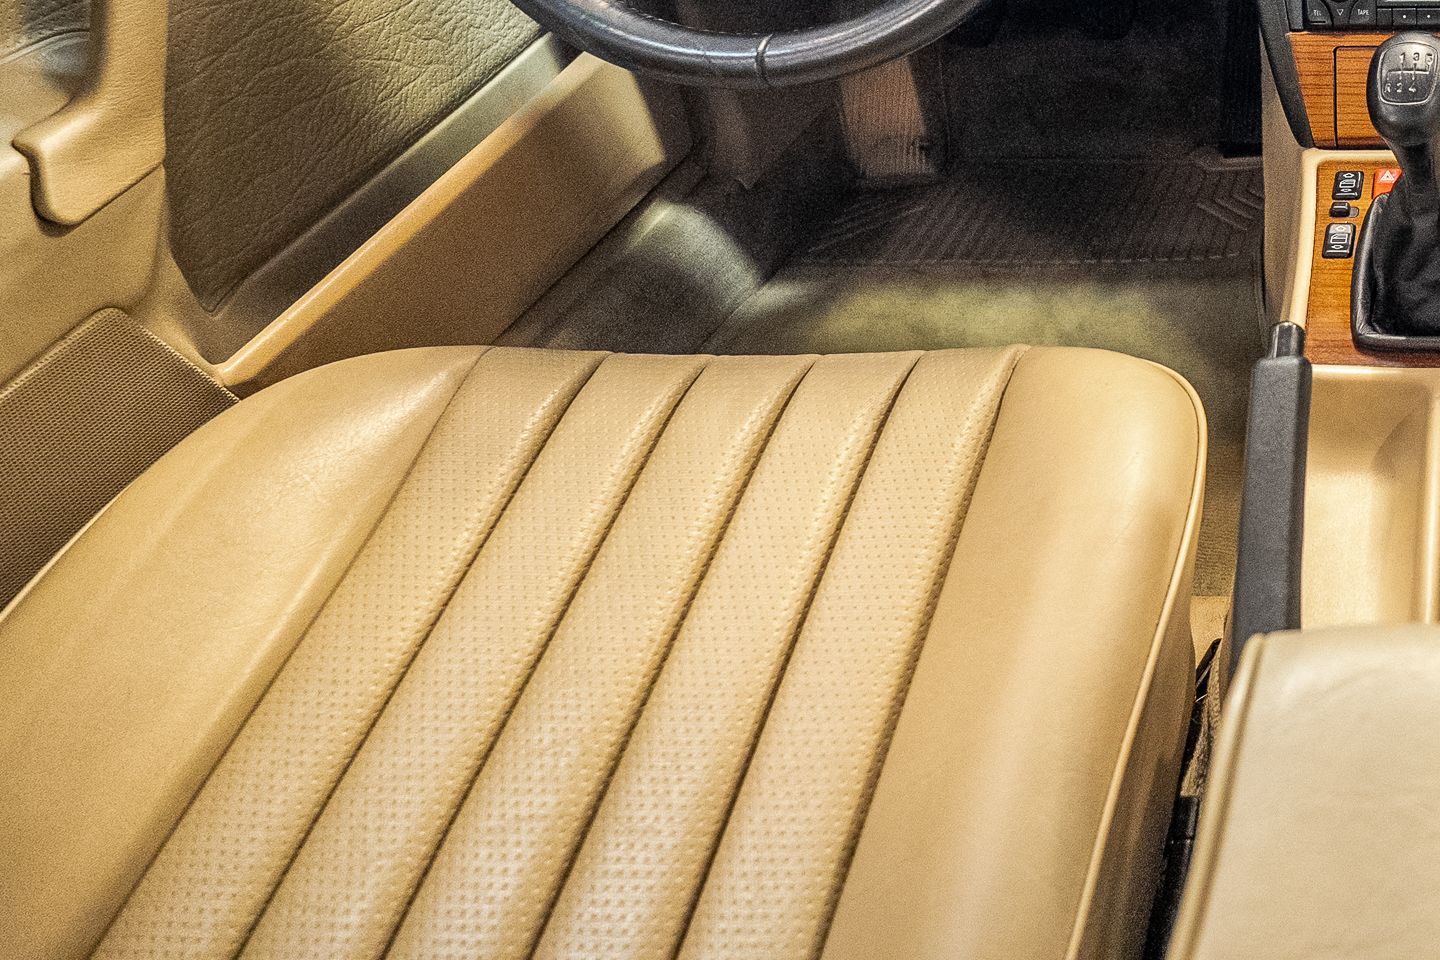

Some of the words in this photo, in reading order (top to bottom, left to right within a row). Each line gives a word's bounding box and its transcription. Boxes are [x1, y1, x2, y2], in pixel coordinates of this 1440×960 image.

[1400, 52, 1406, 63] 1
[1413, 52, 1420, 61] 3
[1397, 82, 1403, 93] 2
[1408, 81, 1417, 93] 4
